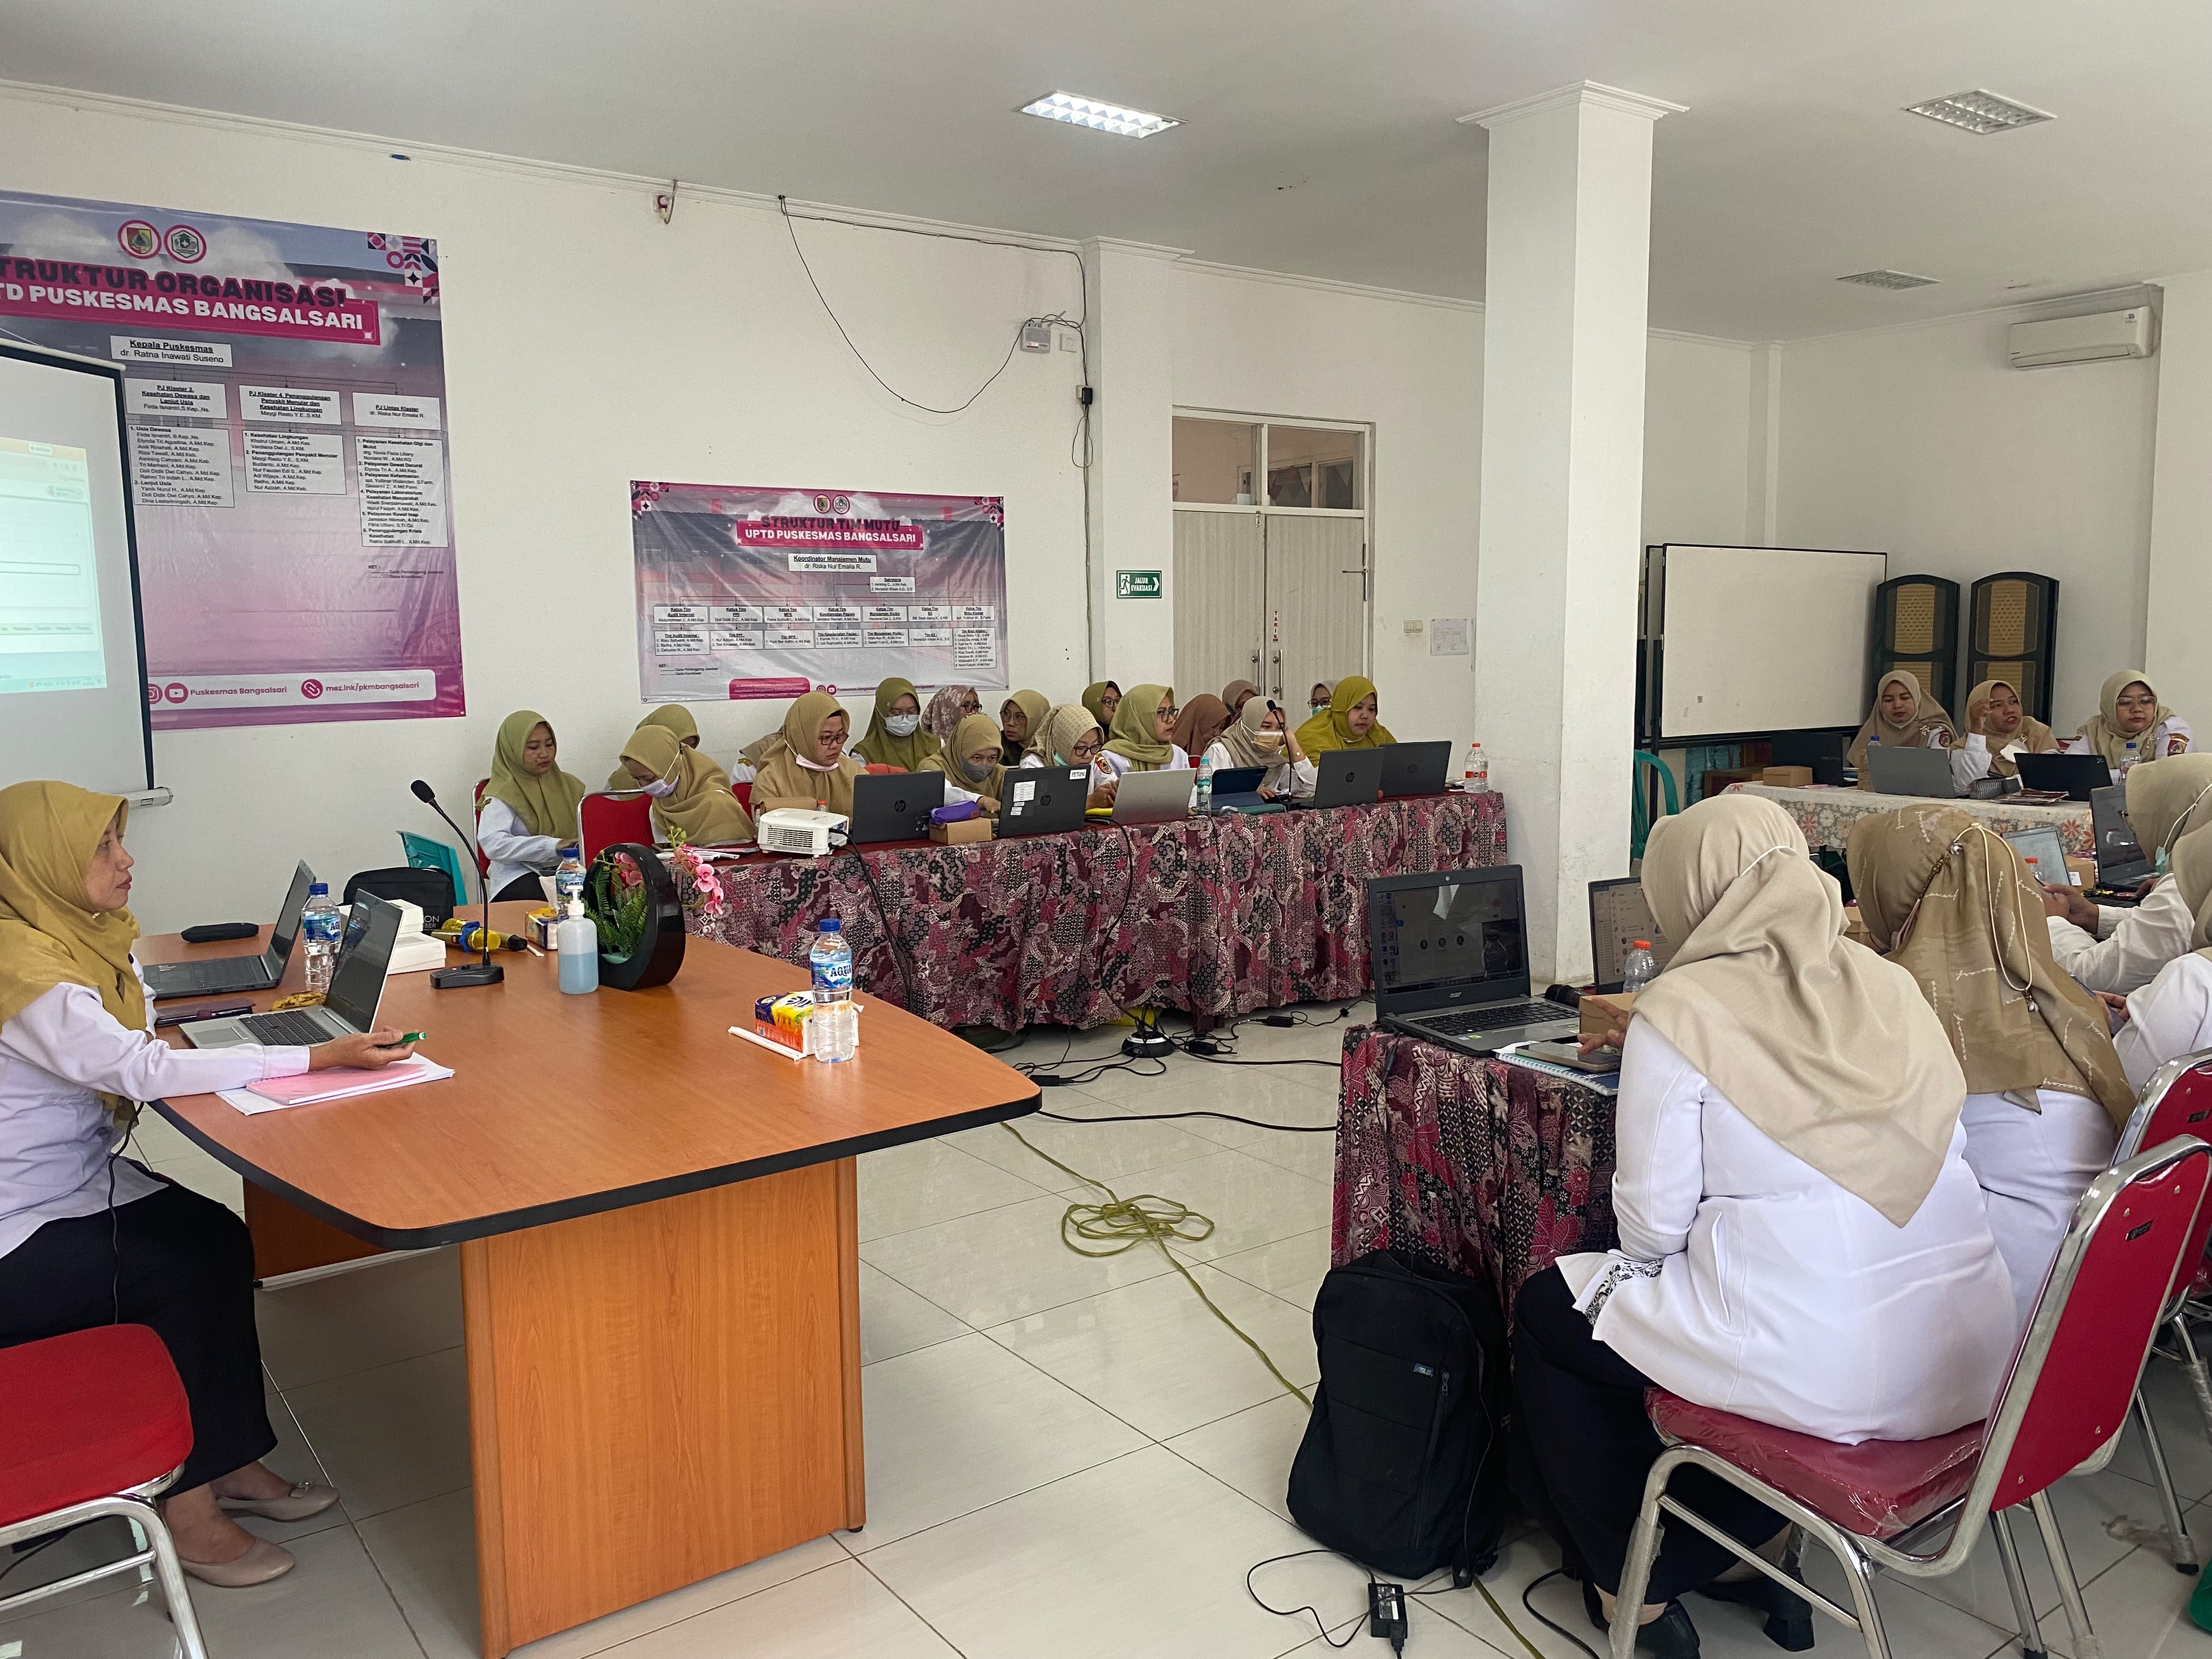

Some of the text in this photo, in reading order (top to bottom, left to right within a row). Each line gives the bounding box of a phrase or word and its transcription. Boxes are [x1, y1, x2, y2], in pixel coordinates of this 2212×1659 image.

[156, 272, 346, 307] ORGANISASI
[29, 285, 189, 315] PUSKESMAS
[194, 300, 363, 329] BANGSALSARI
[129, 340, 213, 353] Kepala Puskesmas
[134, 350, 159, 358] Ratna
[161, 352, 191, 360] Inawati
[193, 354, 224, 363] Suseno
[761, 516, 900, 532] STRUKTUR TIM MUTU
[745, 529, 916, 543] UPTD PUSKESMAS BANGSALSARI
[190, 685, 287, 697] Puskesmas Bangsalsari
[830, 964, 851, 977] AQUA
